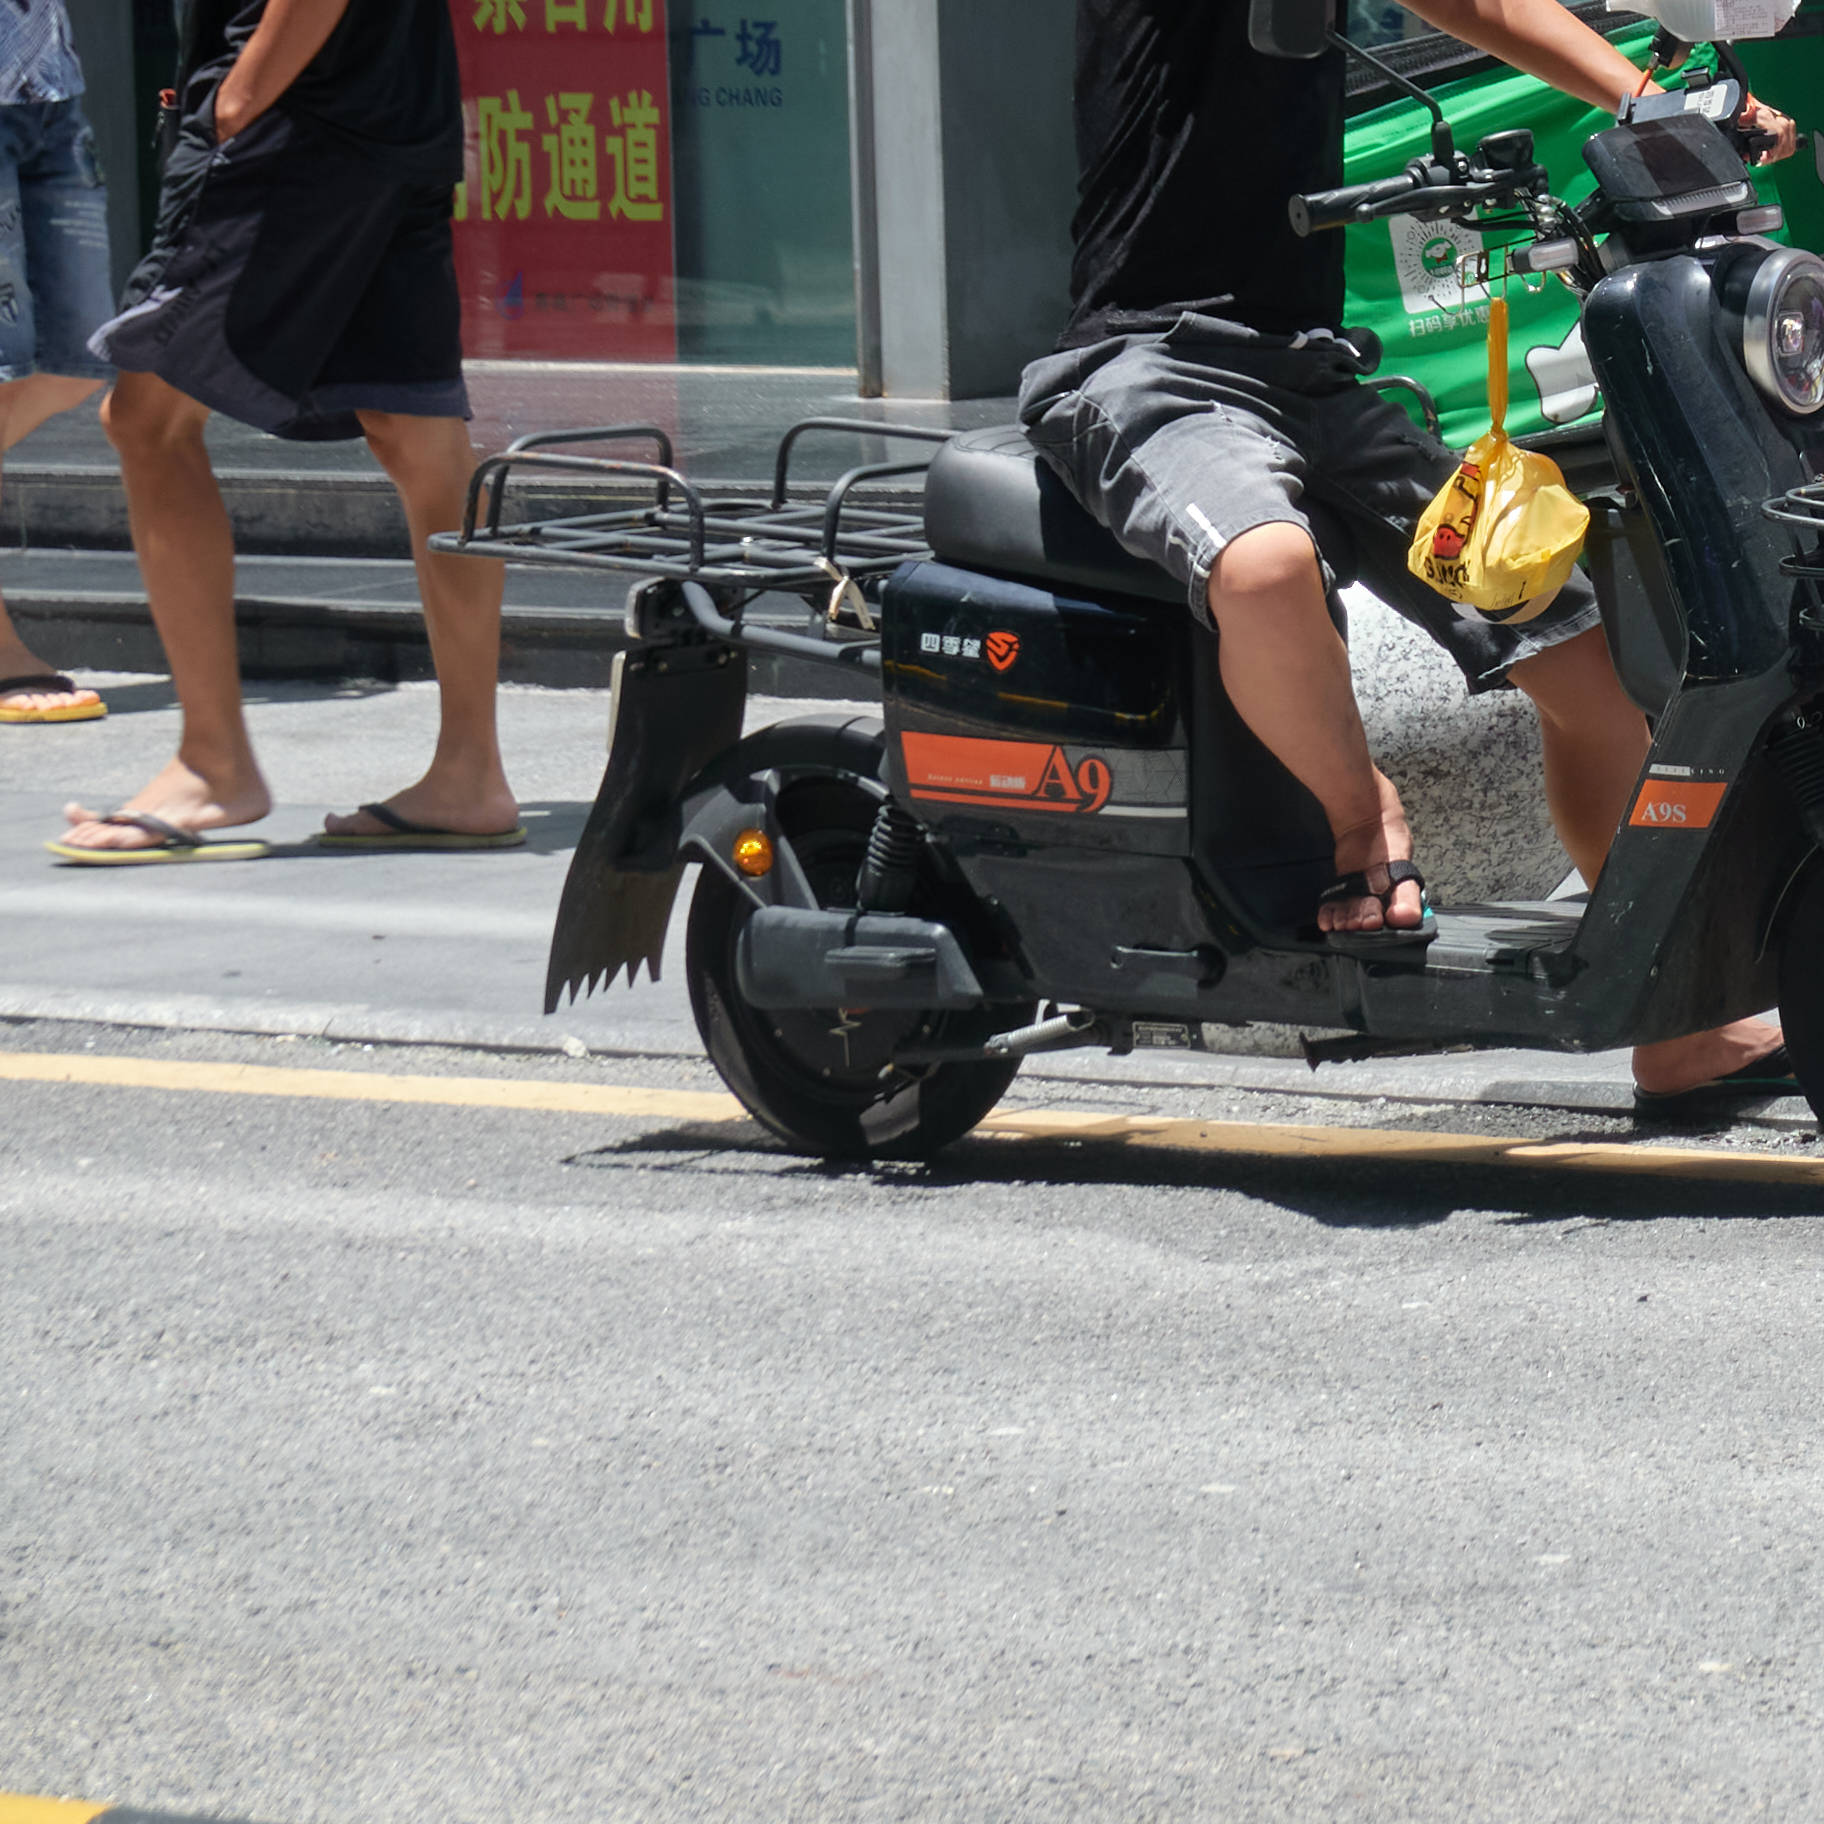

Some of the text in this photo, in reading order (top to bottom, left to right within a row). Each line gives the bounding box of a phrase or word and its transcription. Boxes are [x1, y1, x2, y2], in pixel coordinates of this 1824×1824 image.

[716, 87, 783, 108] CHANG
[455, 89, 664, 221] 防通道
[1033, 743, 1111, 813] A9
[1641, 801, 1687, 824] A9S
